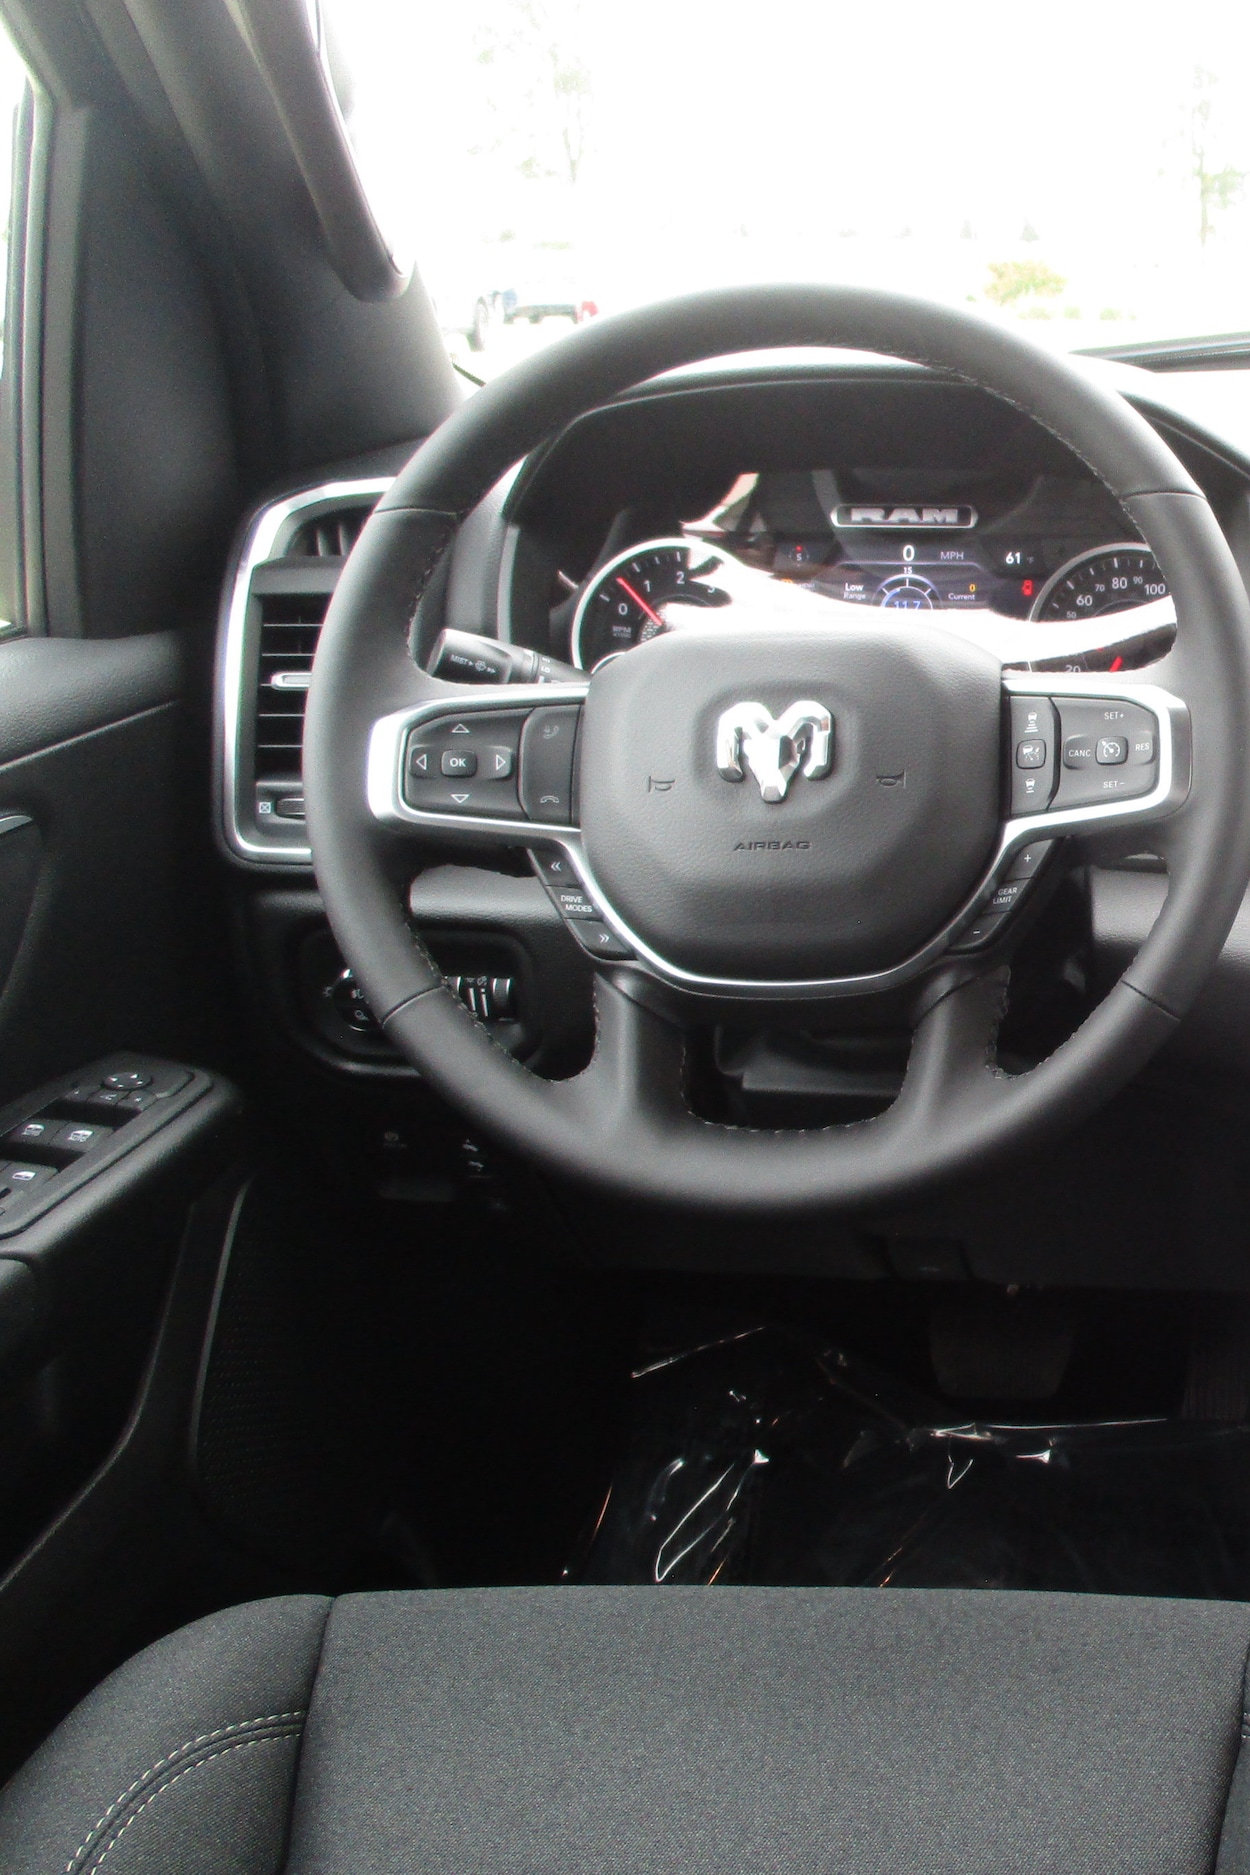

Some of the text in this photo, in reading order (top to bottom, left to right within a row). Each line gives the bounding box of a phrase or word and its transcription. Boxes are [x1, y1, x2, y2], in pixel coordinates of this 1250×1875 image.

[851, 507, 959, 524] RAM
[902, 545, 915, 562] 0
[940, 552, 964, 561] MPH
[1005, 552, 1021, 564] 61
[676, 571, 685, 585] 2
[1132, 577, 1144, 585] 90
[643, 580, 650, 592] 1
[845, 583, 864, 592] Low
[969, 584, 976, 592] 0
[1095, 584, 1105, 592] 70
[1112, 577, 1128, 590] 80
[1144, 584, 1166, 595] 100
[843, 592, 866, 601] Range
[948, 592, 976, 601] Current
[1076, 595, 1093, 607] 60
[618, 603, 628, 616] 0
[1066, 611, 1077, 619] 50
[612, 625, 632, 633] RPM
[1135, 743, 1150, 751] RES
[1068, 749, 1091, 758] CANC
[449, 758, 467, 767] OK
[734, 841, 811, 850] AIRBAG
[998, 887, 1017, 895] GEAR
[560, 895, 583, 903] DRIVE
[993, 896, 1013, 904] LIMIT
[565, 904, 593, 912] MODES
